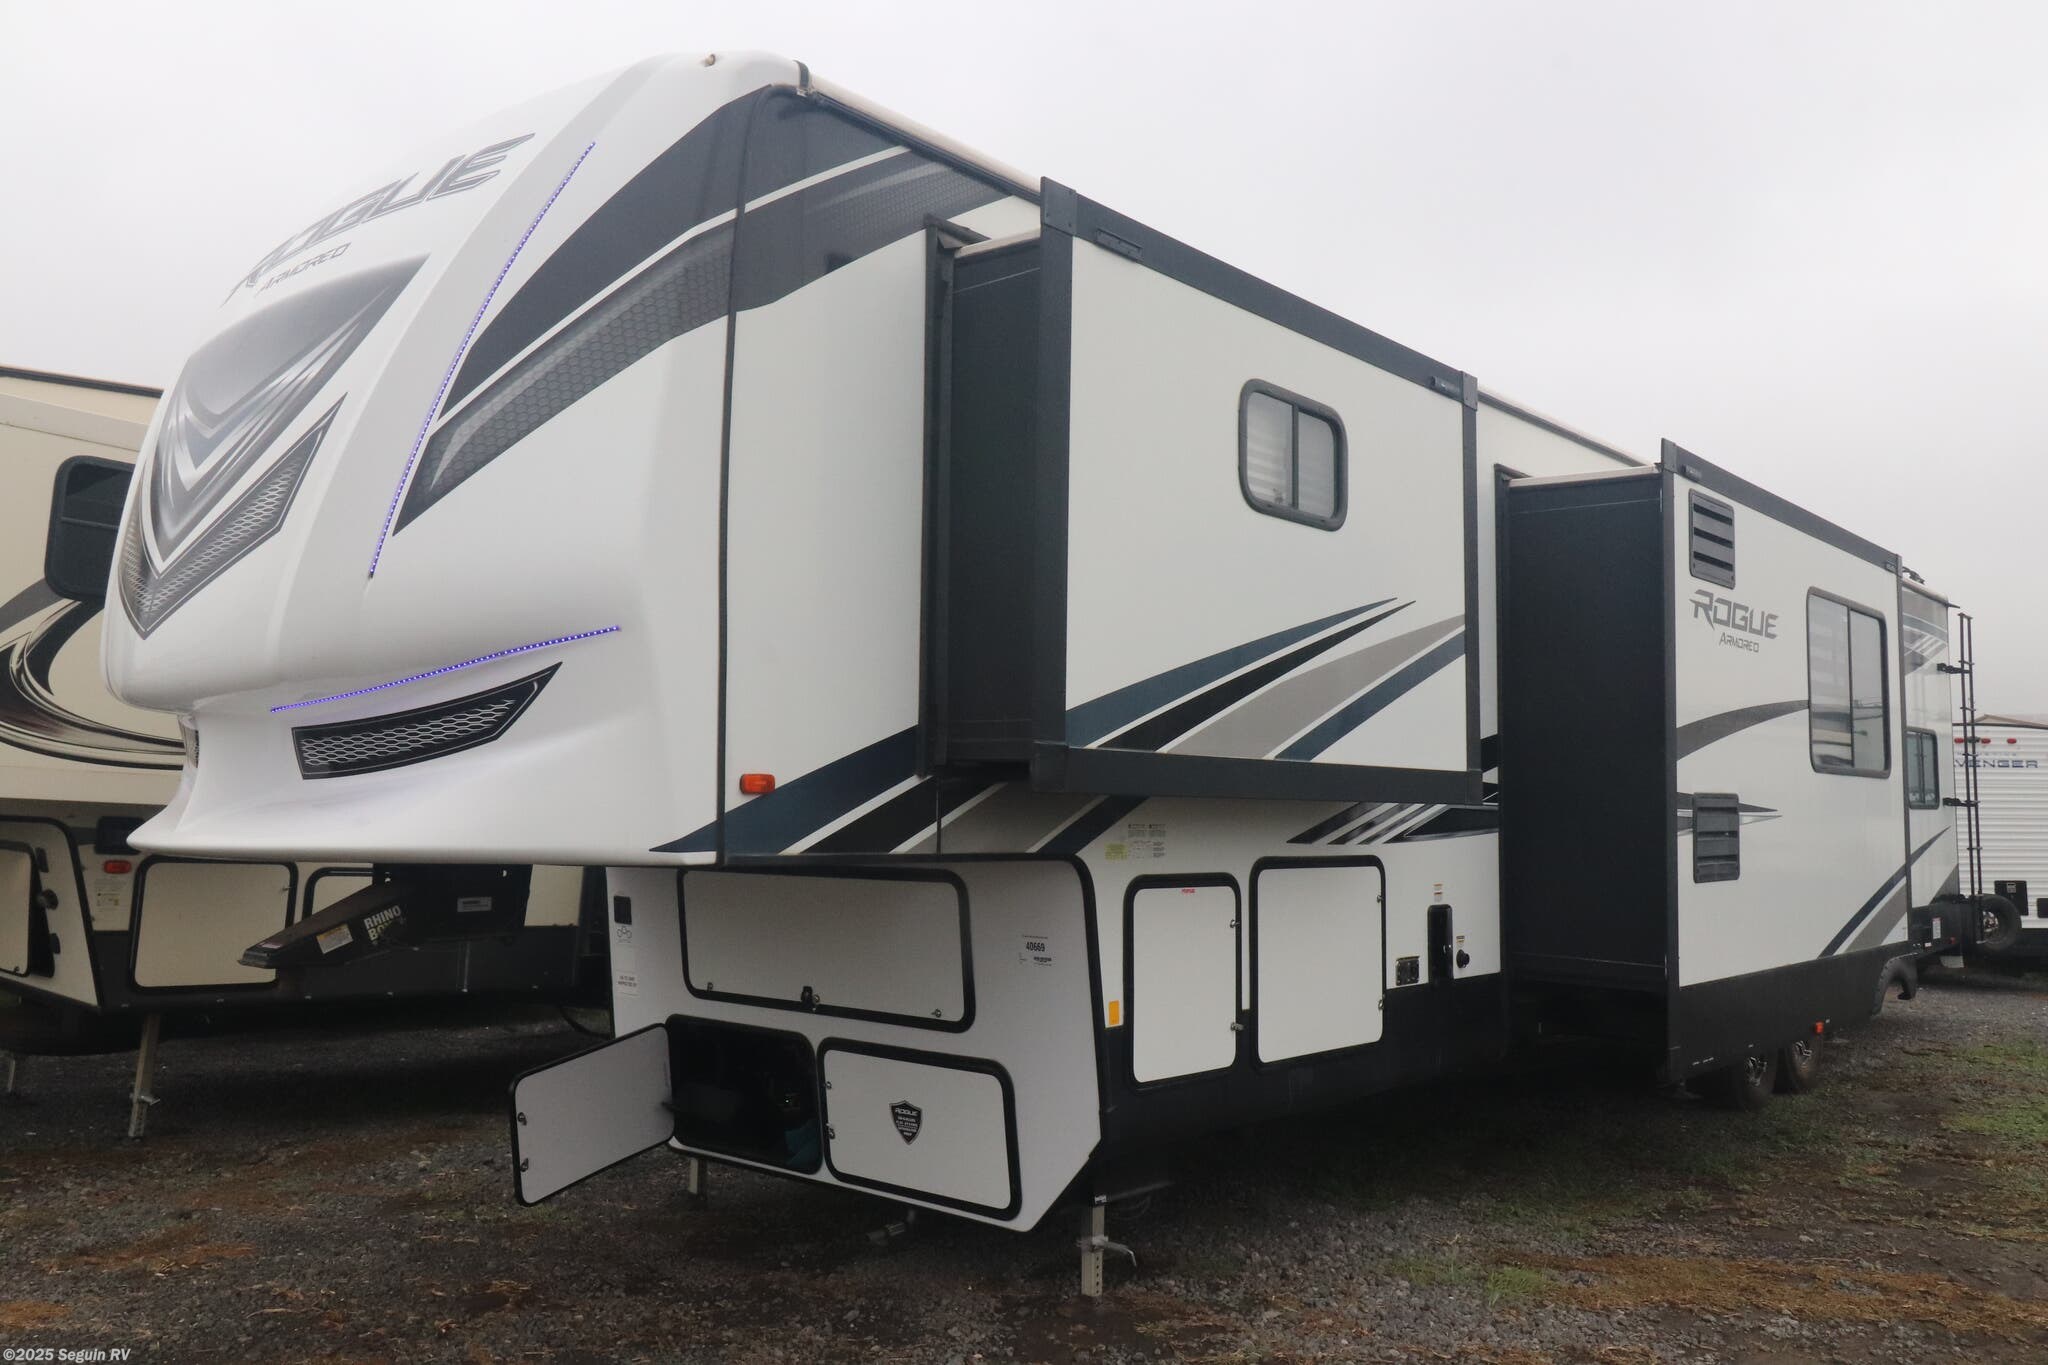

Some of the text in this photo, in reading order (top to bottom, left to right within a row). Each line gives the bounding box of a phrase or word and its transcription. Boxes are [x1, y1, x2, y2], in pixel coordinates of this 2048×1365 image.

[221, 132, 536, 307] ROGUE
[1689, 590, 1779, 640] ROGUE
[1954, 759, 2039, 769] VENGER
[364, 905, 402, 929] RHINO
